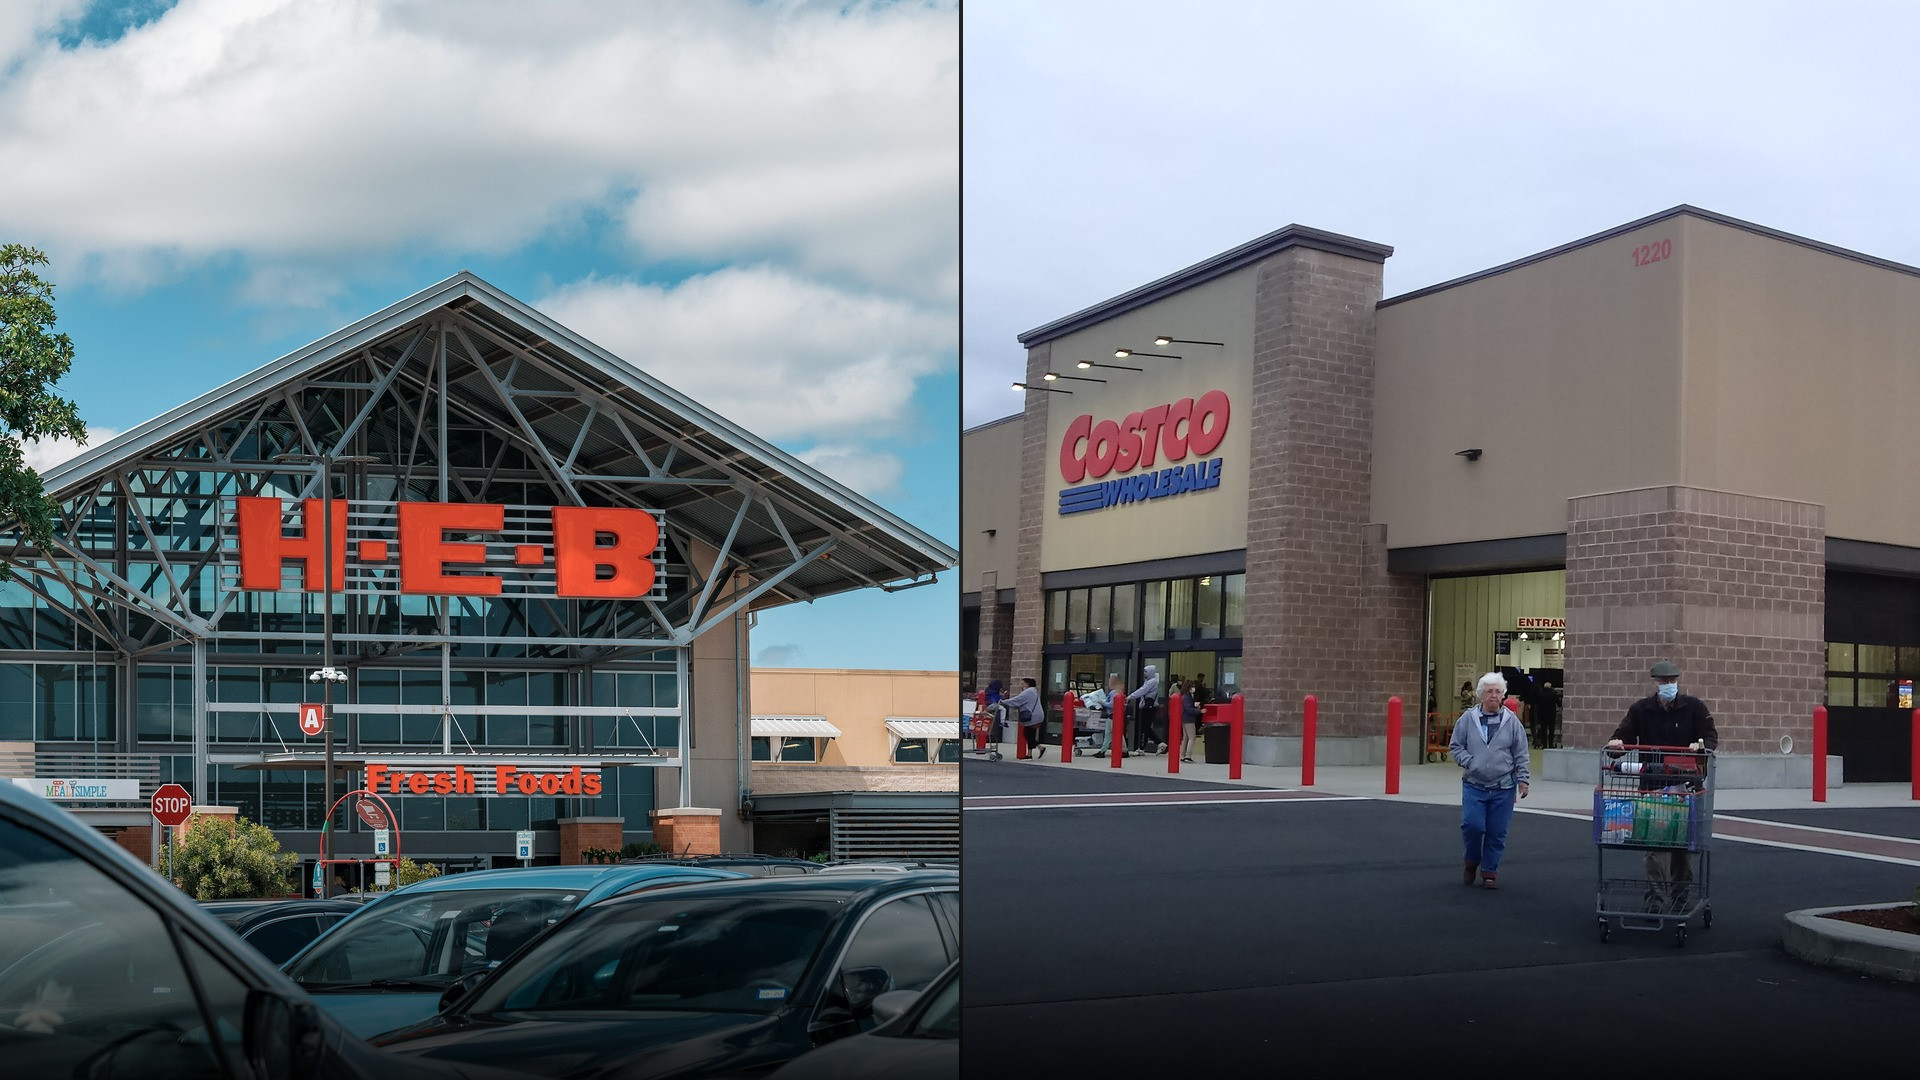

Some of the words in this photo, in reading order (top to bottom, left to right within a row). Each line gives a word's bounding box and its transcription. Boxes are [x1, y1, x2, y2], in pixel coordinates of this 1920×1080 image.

[1632, 239, 1671, 267] 1220
[1060, 390, 1230, 483] COSTCO
[1102, 457, 1222, 507] WHOLESALE
[304, 708, 319, 728] A
[46, 786, 71, 797] MEAL
[75, 786, 107, 797] SIMPLE
[367, 764, 475, 794] Fresh
[496, 765, 602, 795] Foods
[154, 797, 189, 813] STOP
